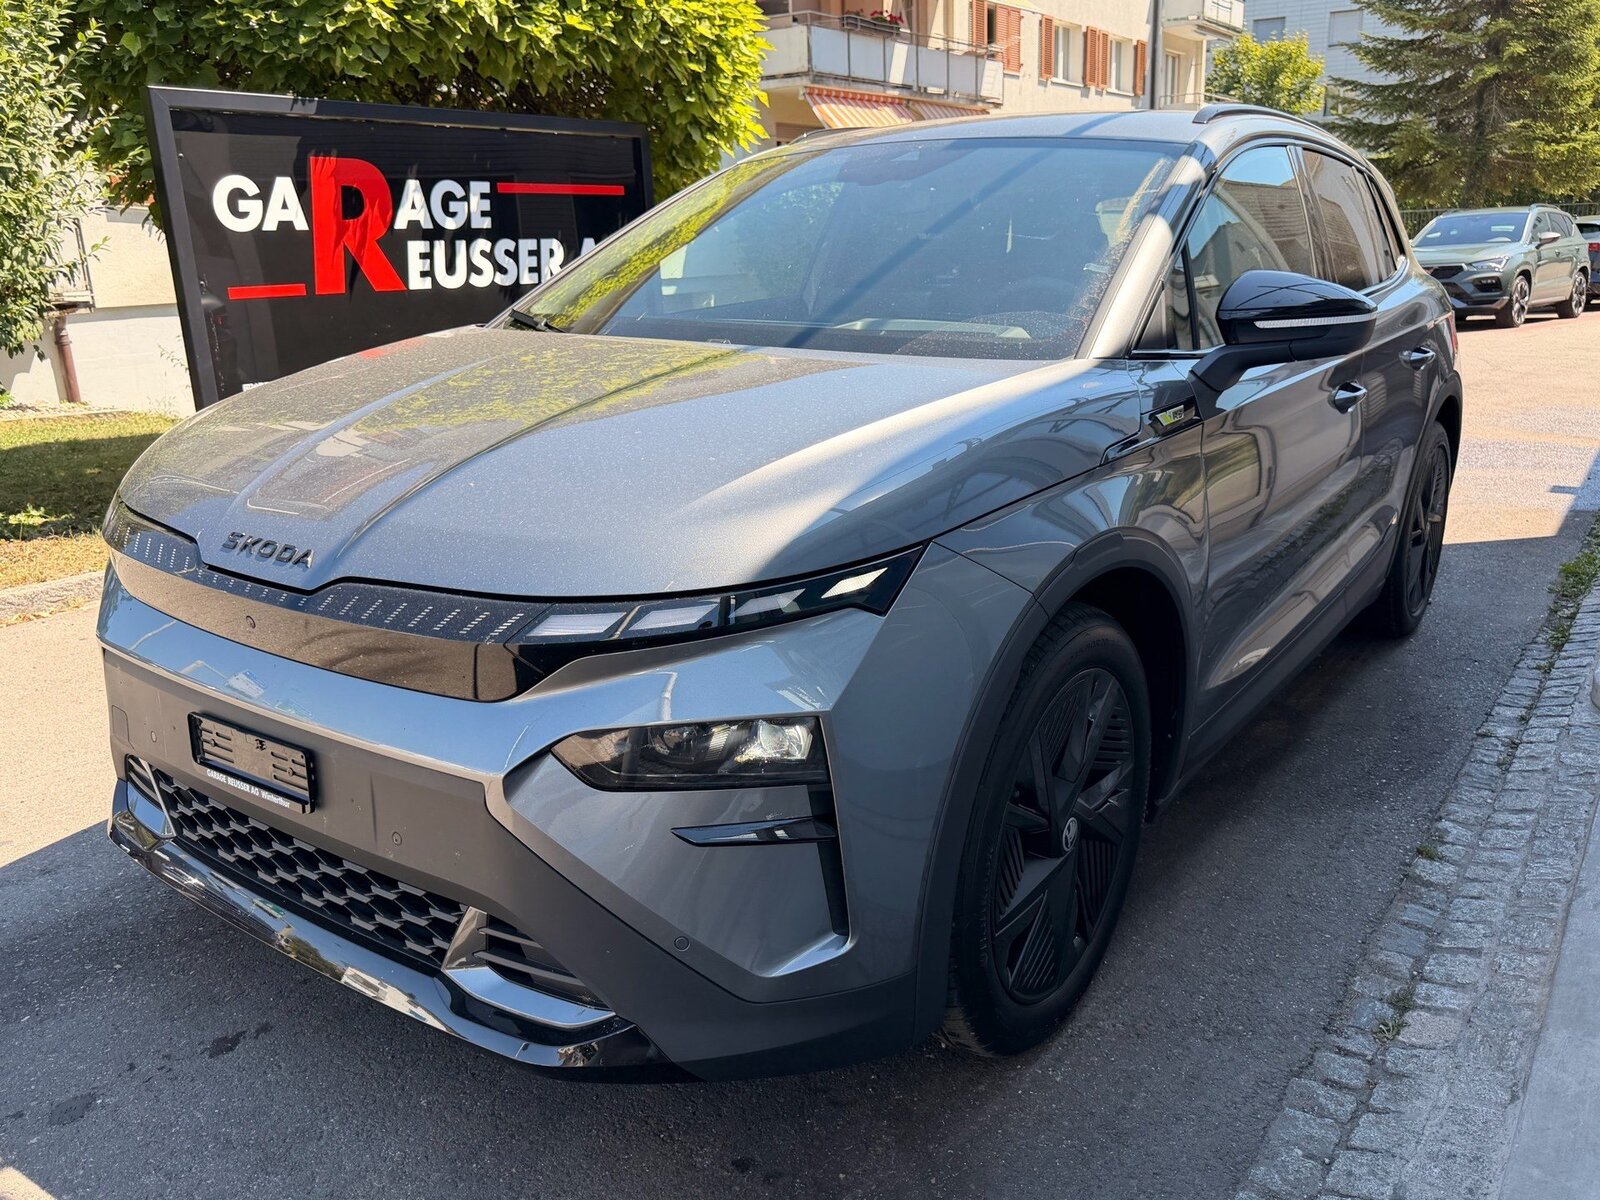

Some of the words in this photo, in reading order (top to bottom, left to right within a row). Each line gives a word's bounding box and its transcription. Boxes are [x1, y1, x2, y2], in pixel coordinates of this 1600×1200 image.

[207, 769, 227, 783] GARAGE
[227, 777, 250, 792] REUSSER
[251, 786, 259, 796] AG
